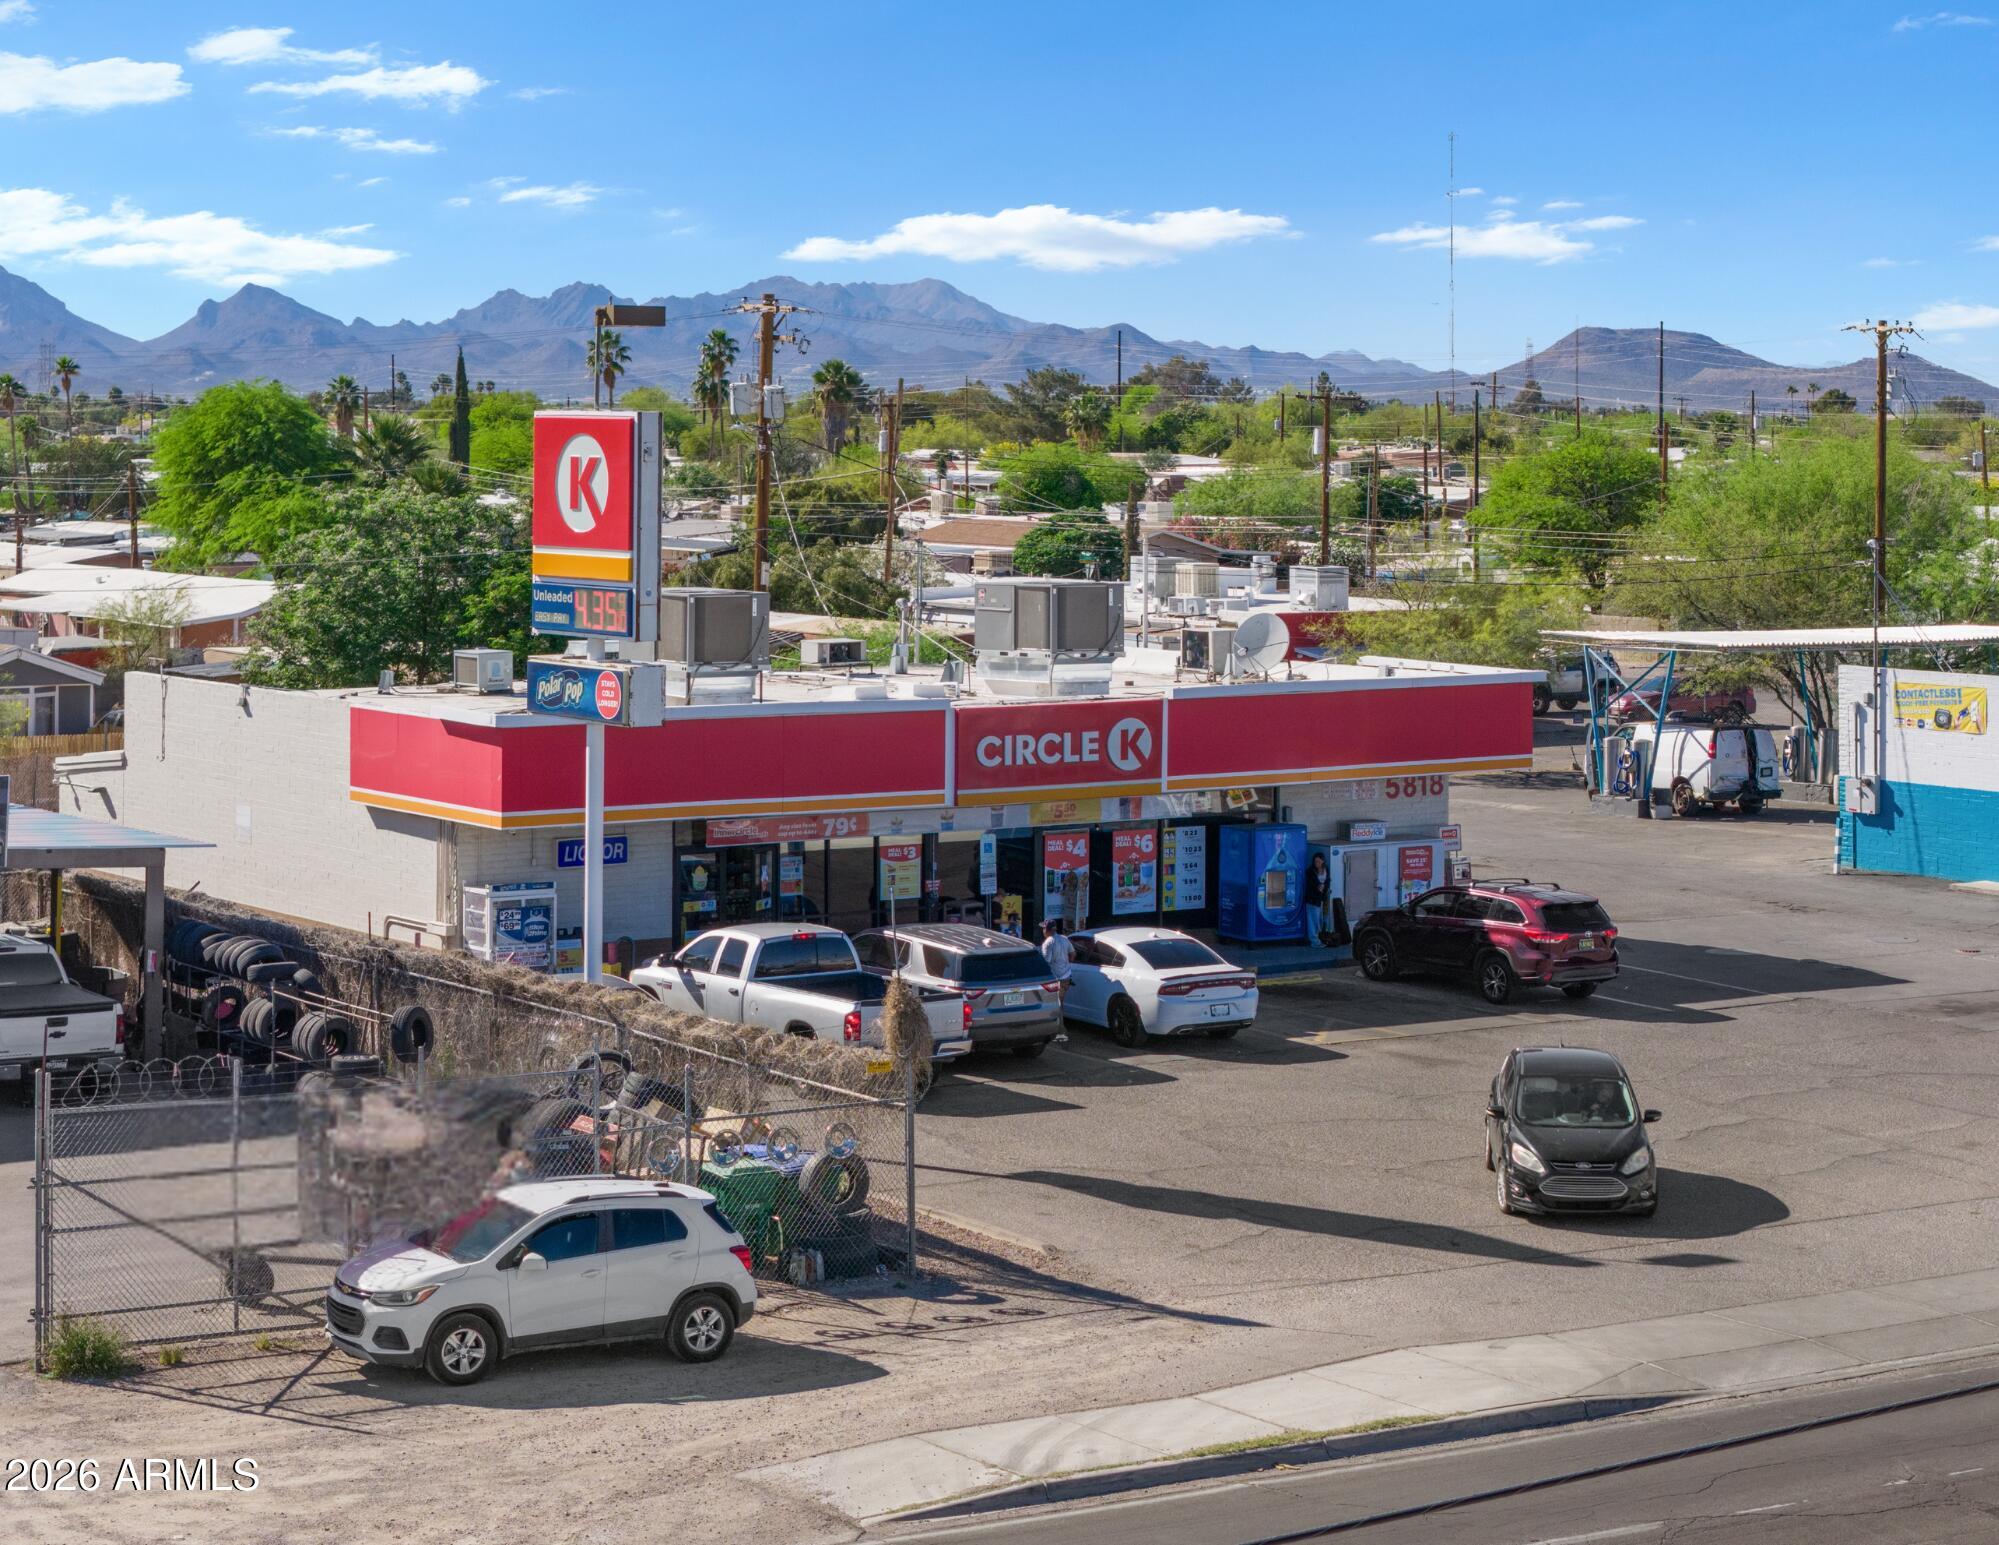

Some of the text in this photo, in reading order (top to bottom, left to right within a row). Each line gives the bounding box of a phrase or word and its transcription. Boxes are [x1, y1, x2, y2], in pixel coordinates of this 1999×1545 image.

[570, 456, 603, 526] K
[533, 589, 573, 603] Unleaded
[538, 676, 563, 700] Polar
[976, 728, 1148, 768] CIRCLE K
[1385, 776, 1444, 799] 5818
[823, 816, 857, 837] 79¢
[903, 846, 916, 859] $3
[1066, 838, 1087, 857] $4
[1134, 834, 1154, 853] $6
